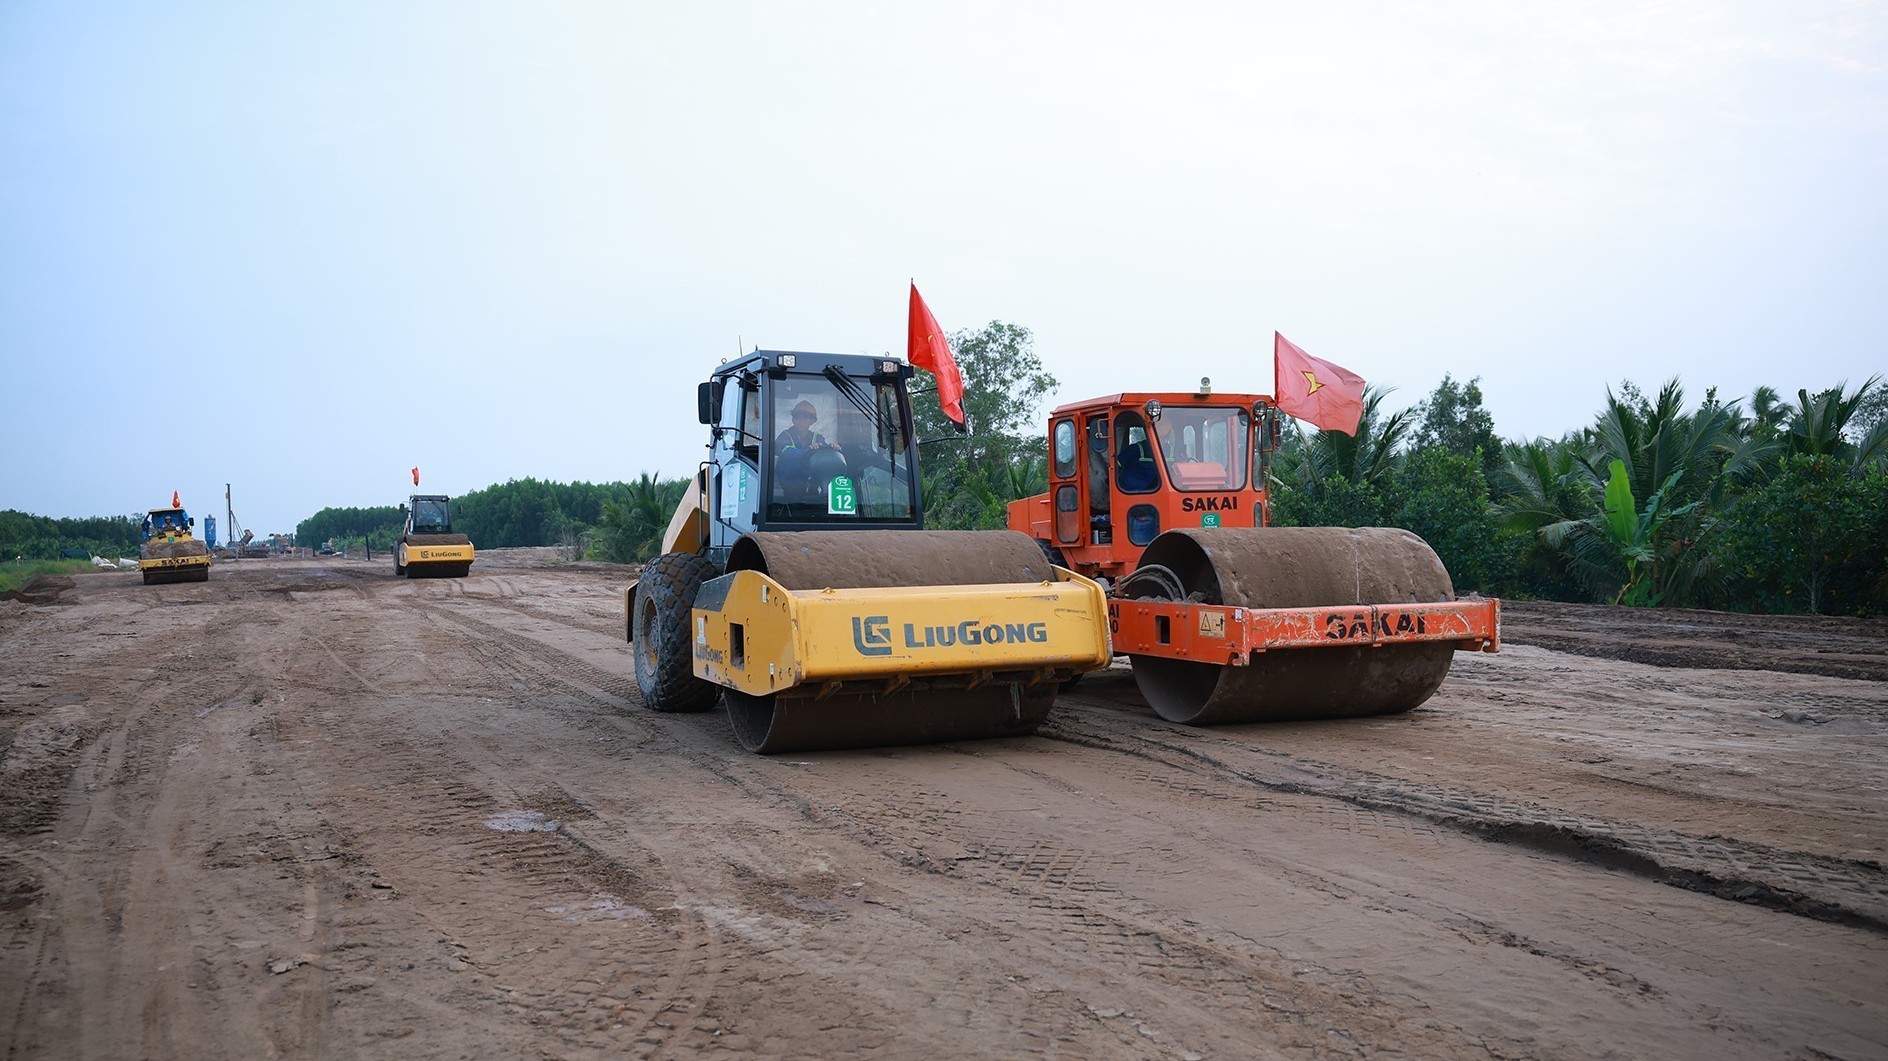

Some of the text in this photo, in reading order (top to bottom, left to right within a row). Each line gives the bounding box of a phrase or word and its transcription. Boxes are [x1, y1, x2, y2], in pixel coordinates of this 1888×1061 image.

[836, 494, 852, 509] 12
[1182, 496, 1238, 512] SAKAI
[161, 558, 189, 566] SAKAI
[1325, 612, 1426, 639] SAKAI
